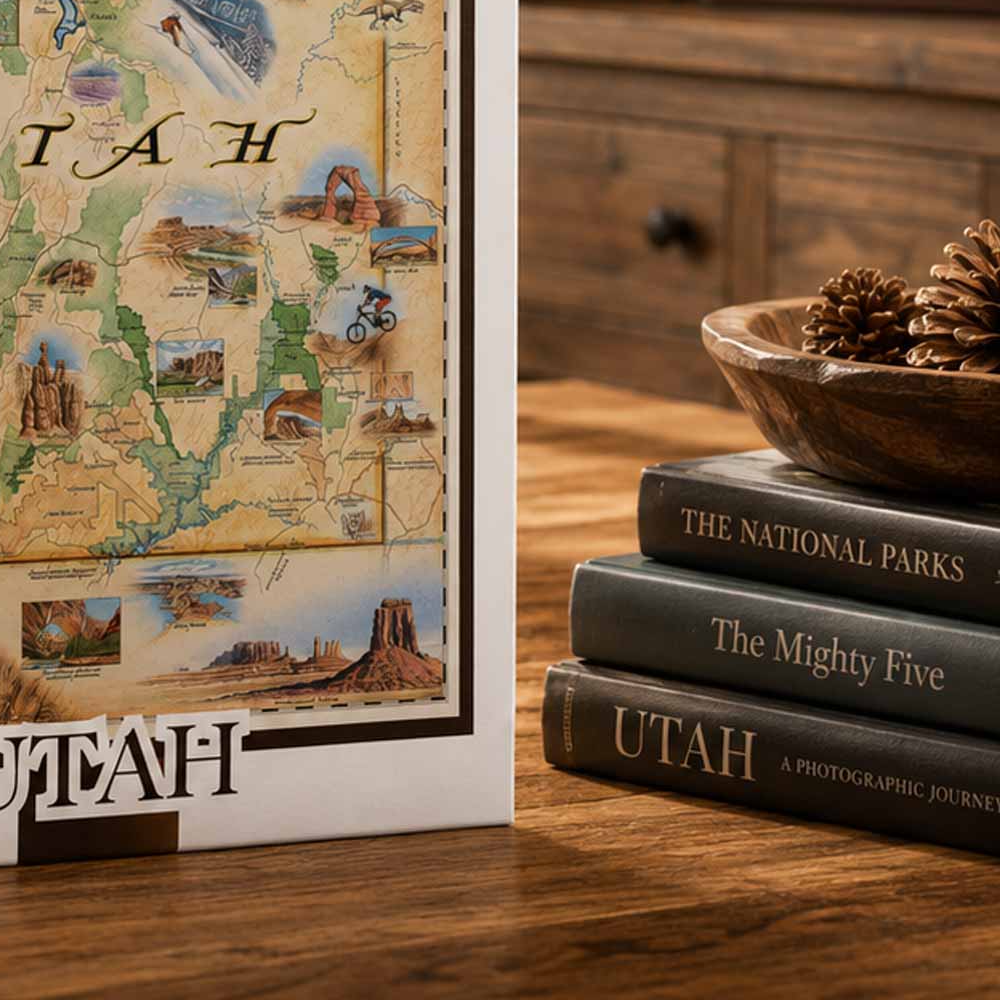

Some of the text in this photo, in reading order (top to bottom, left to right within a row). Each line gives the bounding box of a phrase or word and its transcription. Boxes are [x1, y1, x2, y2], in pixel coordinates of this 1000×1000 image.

[681, 507, 732, 541] THE
[740, 519, 872, 567] NATIONAL
[880, 543, 965, 583] PARKS
[711, 617, 945, 691] The Mighty Five
[613, 705, 758, 783] UTAH
[780, 756, 791, 771] A
[796, 758, 926, 799] PHOTOGRAPHIC
